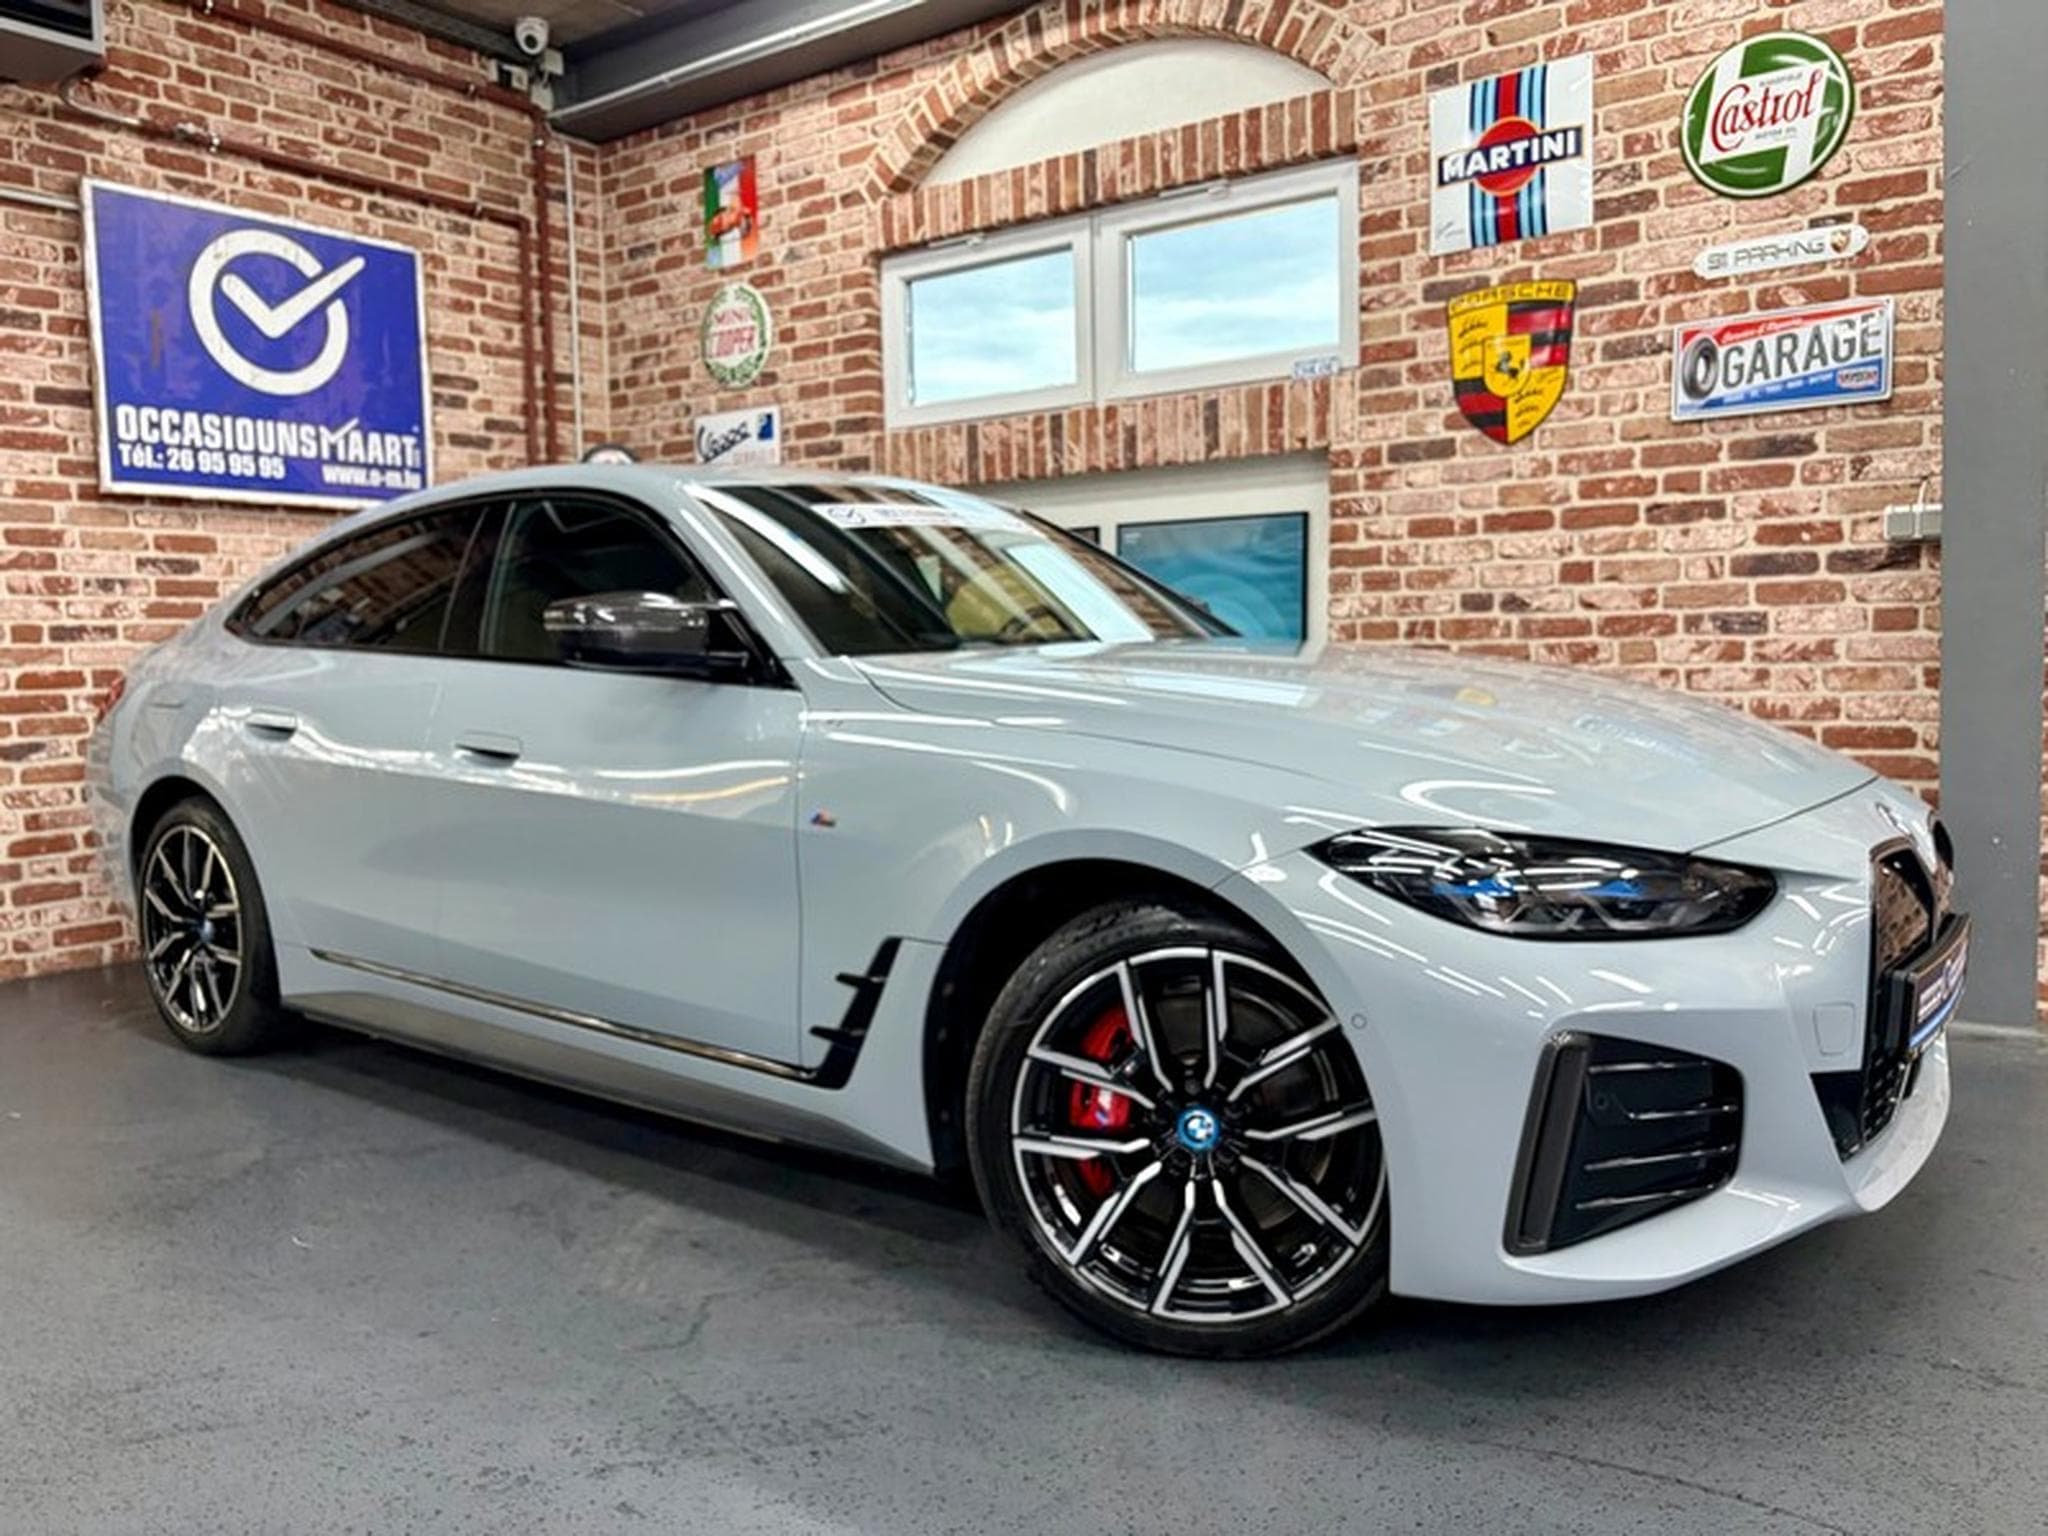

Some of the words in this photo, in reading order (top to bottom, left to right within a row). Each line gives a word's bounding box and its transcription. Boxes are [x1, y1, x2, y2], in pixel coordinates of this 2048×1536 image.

[1711, 69, 1823, 153] Castrol
[1442, 129, 1577, 183] MARTINI
[1734, 238, 1826, 266] PARKING
[1721, 311, 1883, 389] GARAGE
[167, 447, 195, 472] 26
[198, 450, 226, 475] 95
[229, 453, 257, 478] 95
[259, 456, 286, 480] 95
